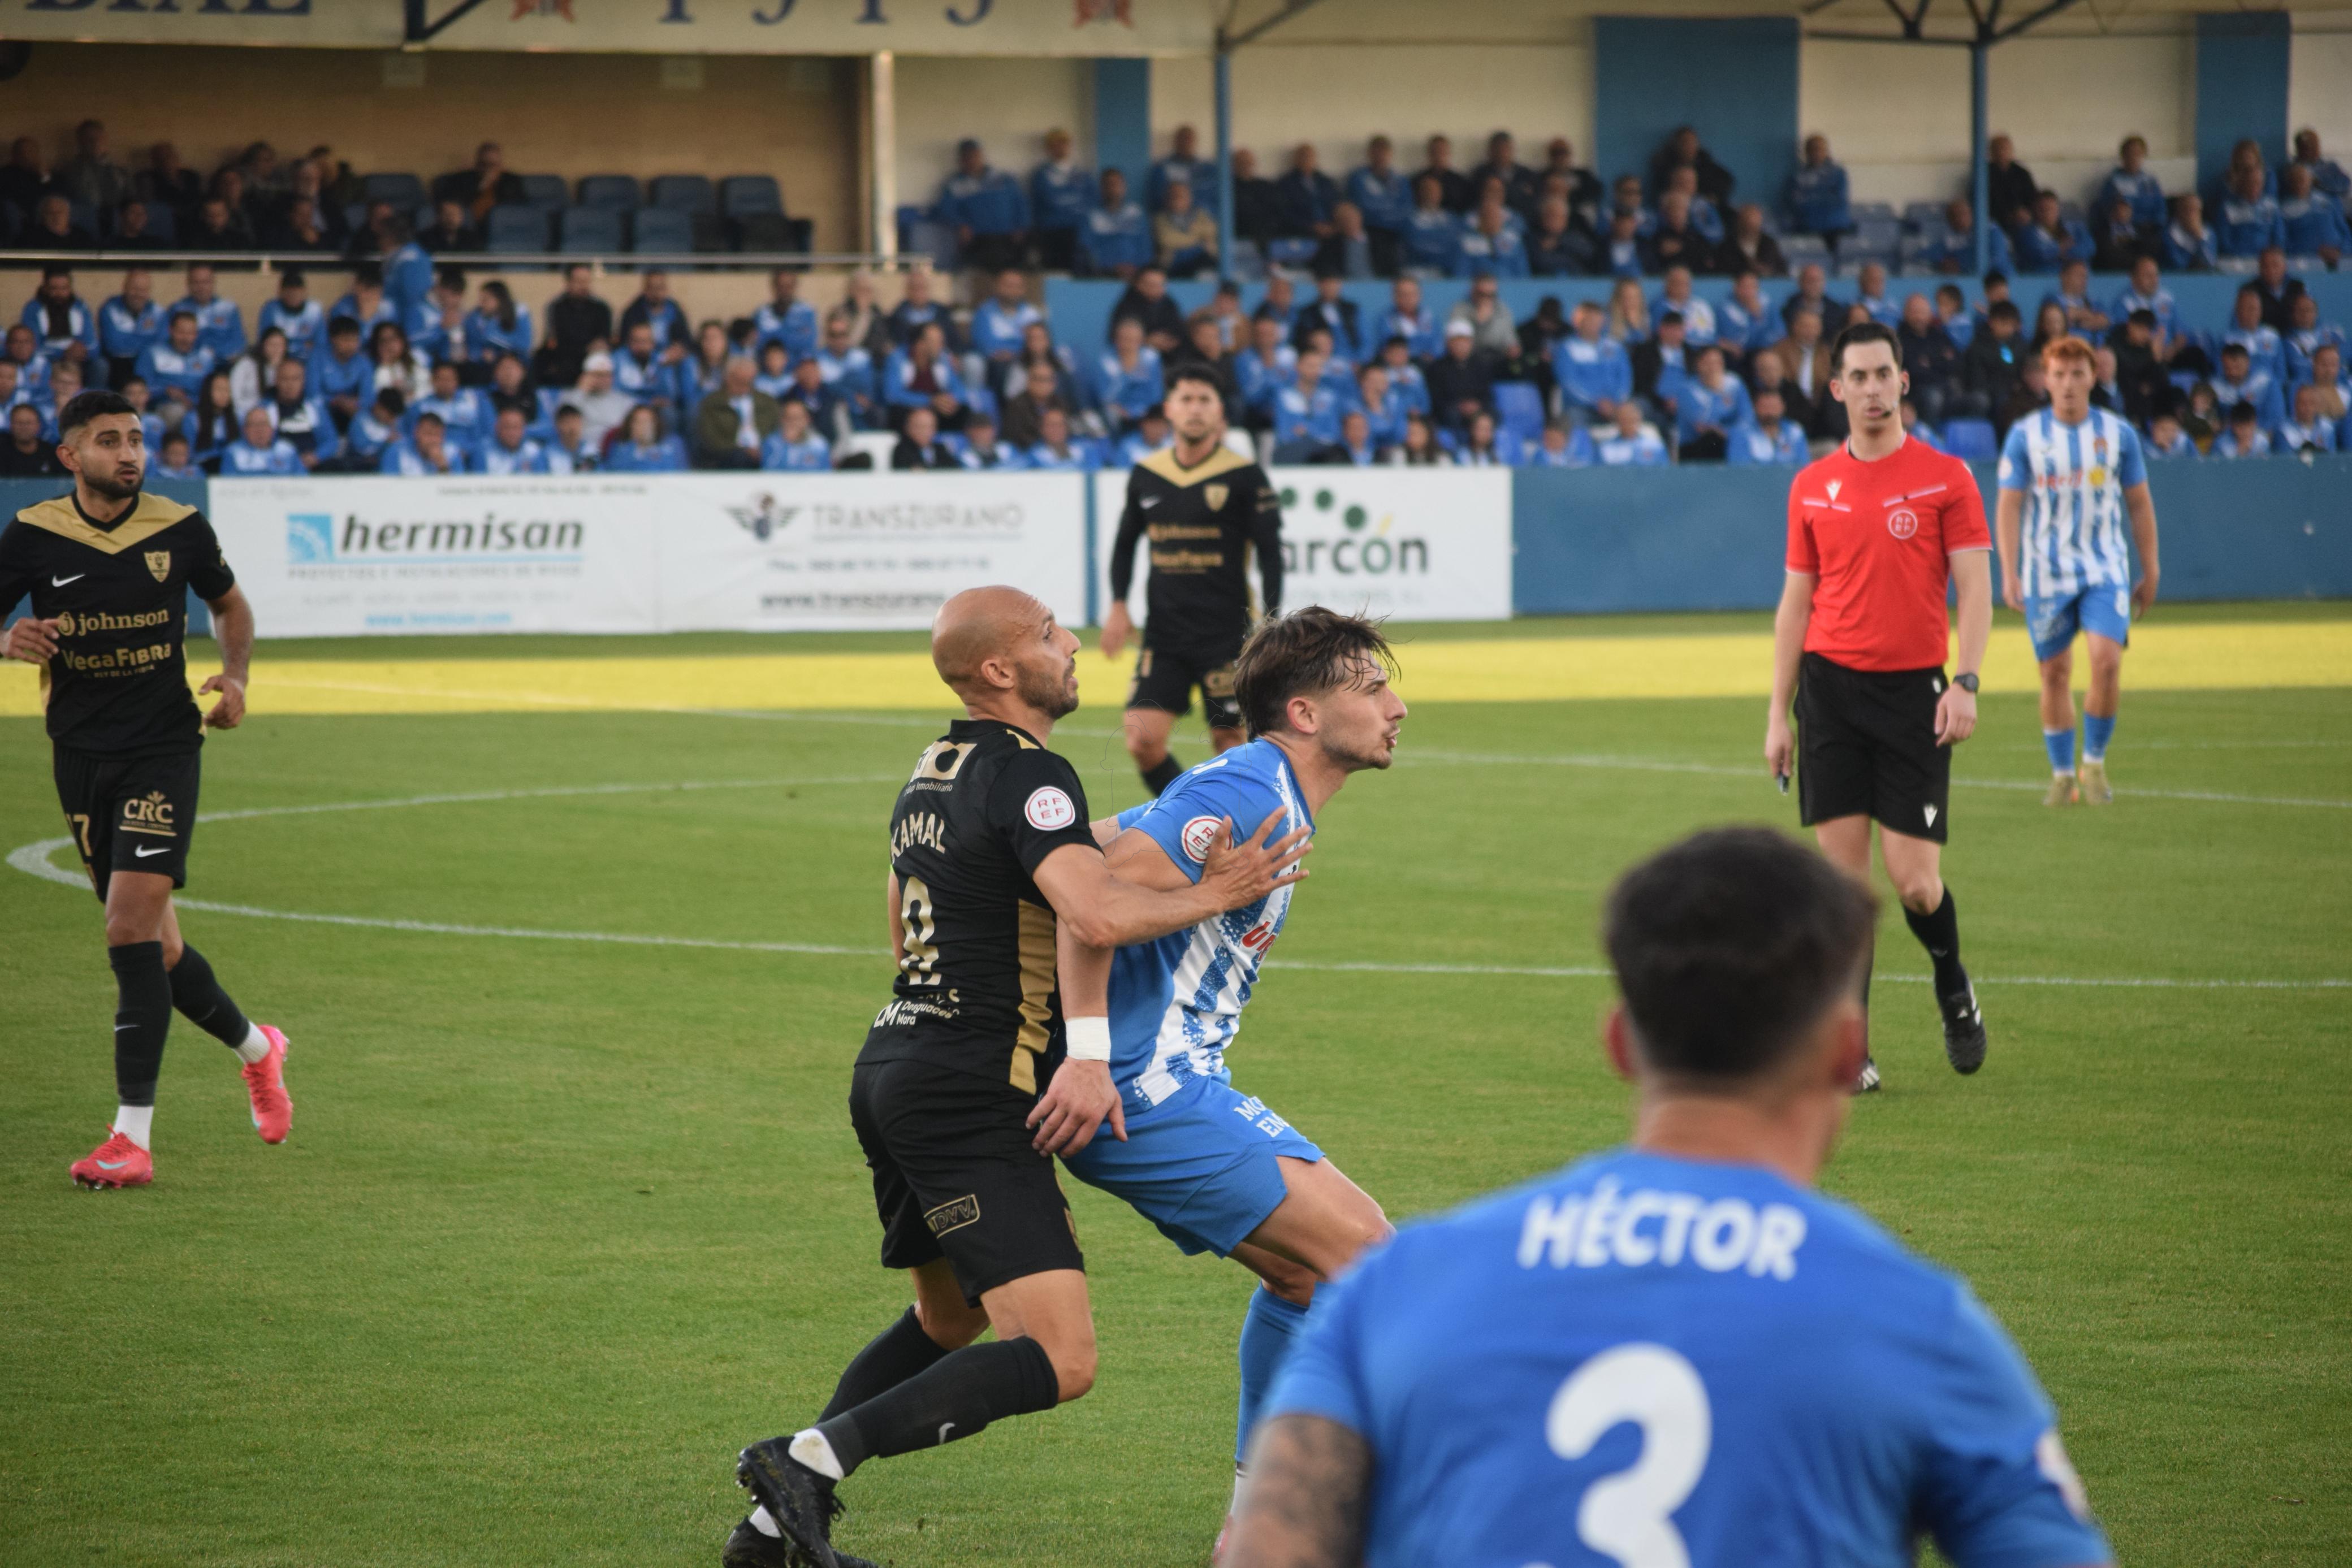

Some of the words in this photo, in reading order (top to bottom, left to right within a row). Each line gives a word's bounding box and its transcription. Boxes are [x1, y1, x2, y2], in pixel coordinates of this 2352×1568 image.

[341, 512, 585, 552] hermisan
[78, 609, 169, 636] johnson
[916, 782, 953, 792] Inmobiliario
[123, 799, 174, 824] CRC
[74, 814, 92, 857] 7
[891, 811, 945, 865] KAMAL
[896, 1013, 916, 1026] Mora
[1517, 1175, 1807, 1281] HÉCTOR
